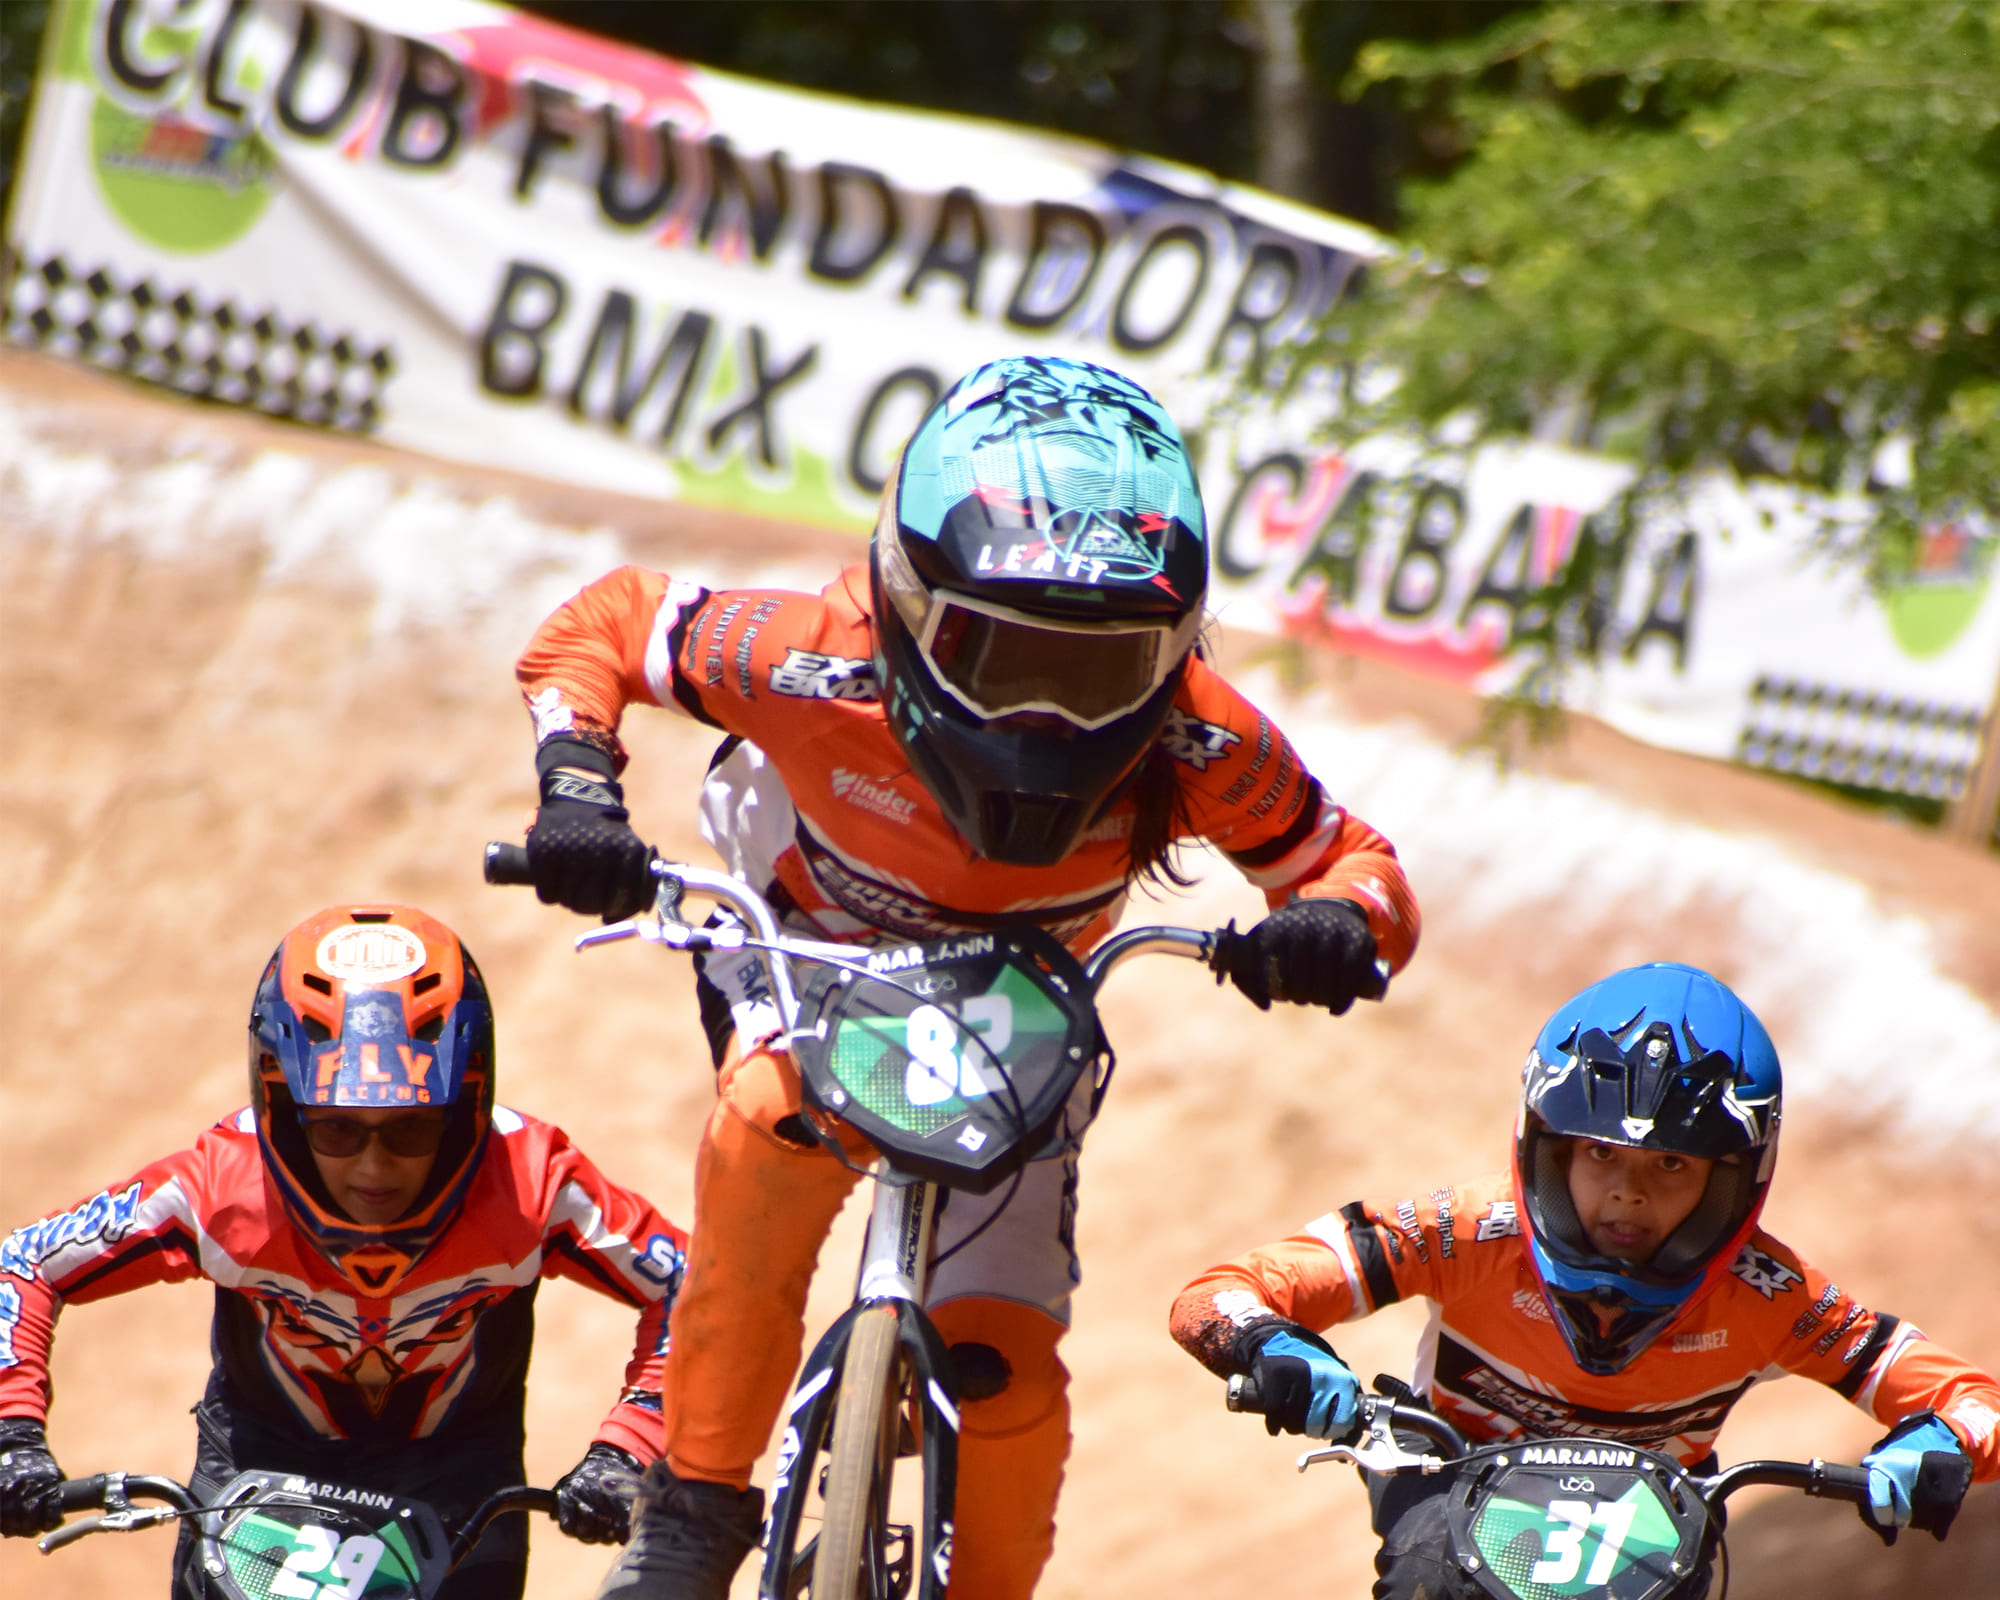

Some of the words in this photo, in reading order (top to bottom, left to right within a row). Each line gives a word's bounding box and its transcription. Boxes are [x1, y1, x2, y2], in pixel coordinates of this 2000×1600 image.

[105, 0, 466, 169] CLUB
[512, 80, 1372, 392] FUNDADOR
[480, 261, 816, 468] BMX
[976, 543, 1108, 584] LEATT
[316, 1043, 433, 1088] FLY
[905, 992, 1013, 1107] 82
[315, 1085, 431, 1103] RACING
[1397, 1200, 1431, 1263] NDUTEX
[1437, 1201, 1454, 1258] Rejiplas
[1814, 1283, 1840, 1315] Rejip
[1672, 1329, 1728, 1353] SUAREZ
[1521, 1448, 1636, 1467] MARLANN
[283, 1477, 394, 1510] MARLANN
[269, 1525, 386, 1600] 29
